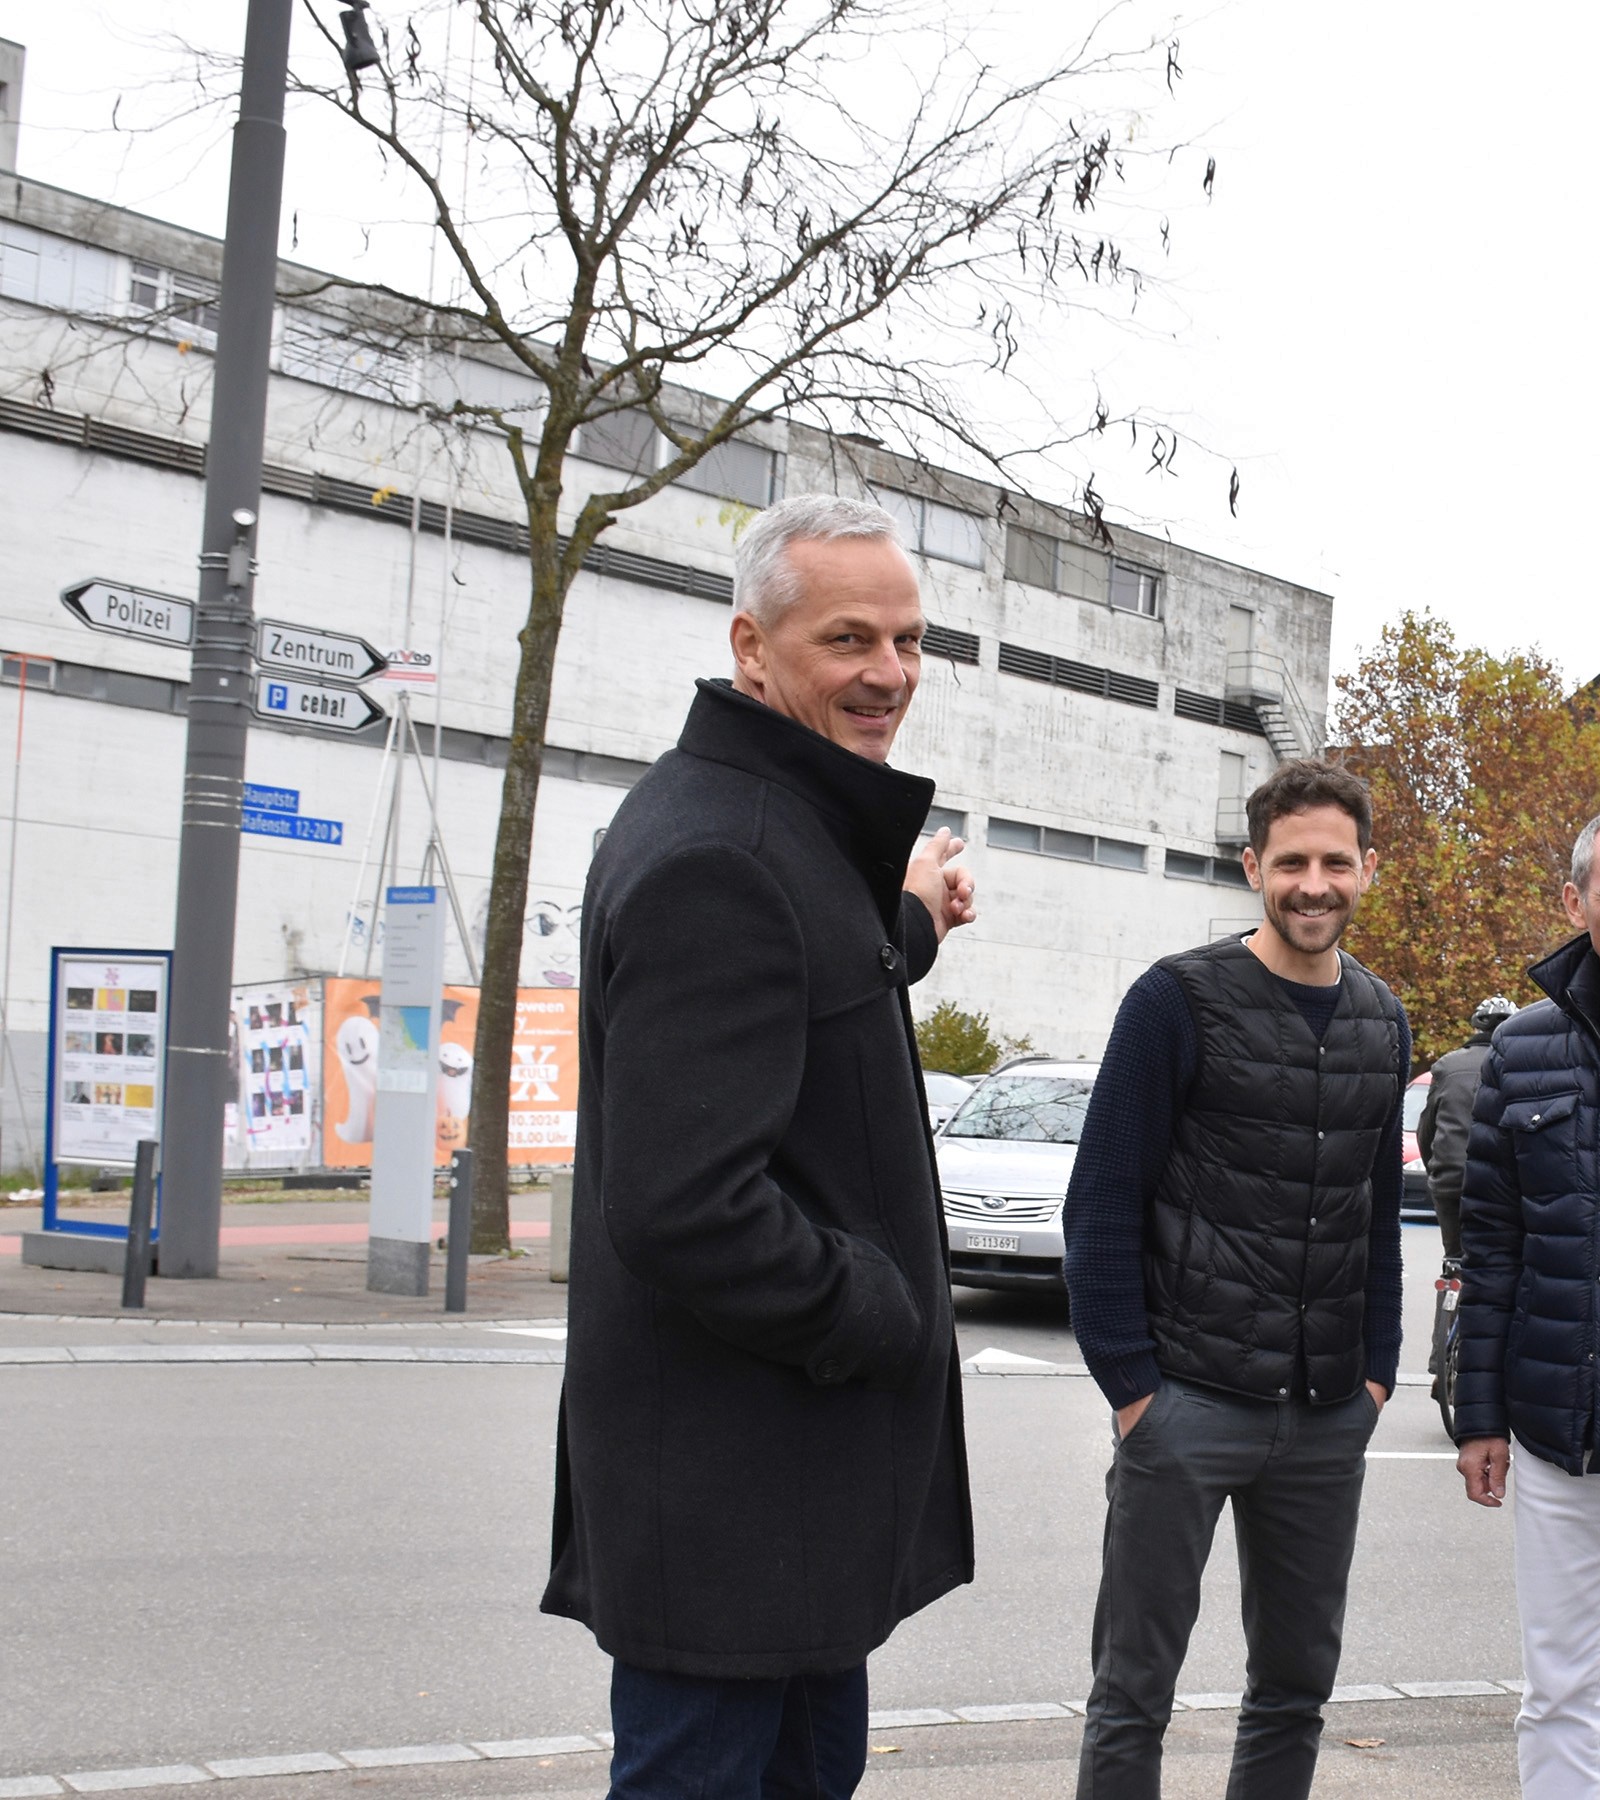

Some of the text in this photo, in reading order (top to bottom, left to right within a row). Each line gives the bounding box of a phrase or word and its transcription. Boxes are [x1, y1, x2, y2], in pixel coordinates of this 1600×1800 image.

[106, 594, 171, 631] Polizei
[270, 633, 354, 670] Zentrum
[300, 692, 346, 719] ceha!
[296, 820, 330, 841] 12-20
[518, 1067, 550, 1079] KULT
[547, 1131, 568, 1143] Uhr
[982, 1236, 1016, 1249] 113691
